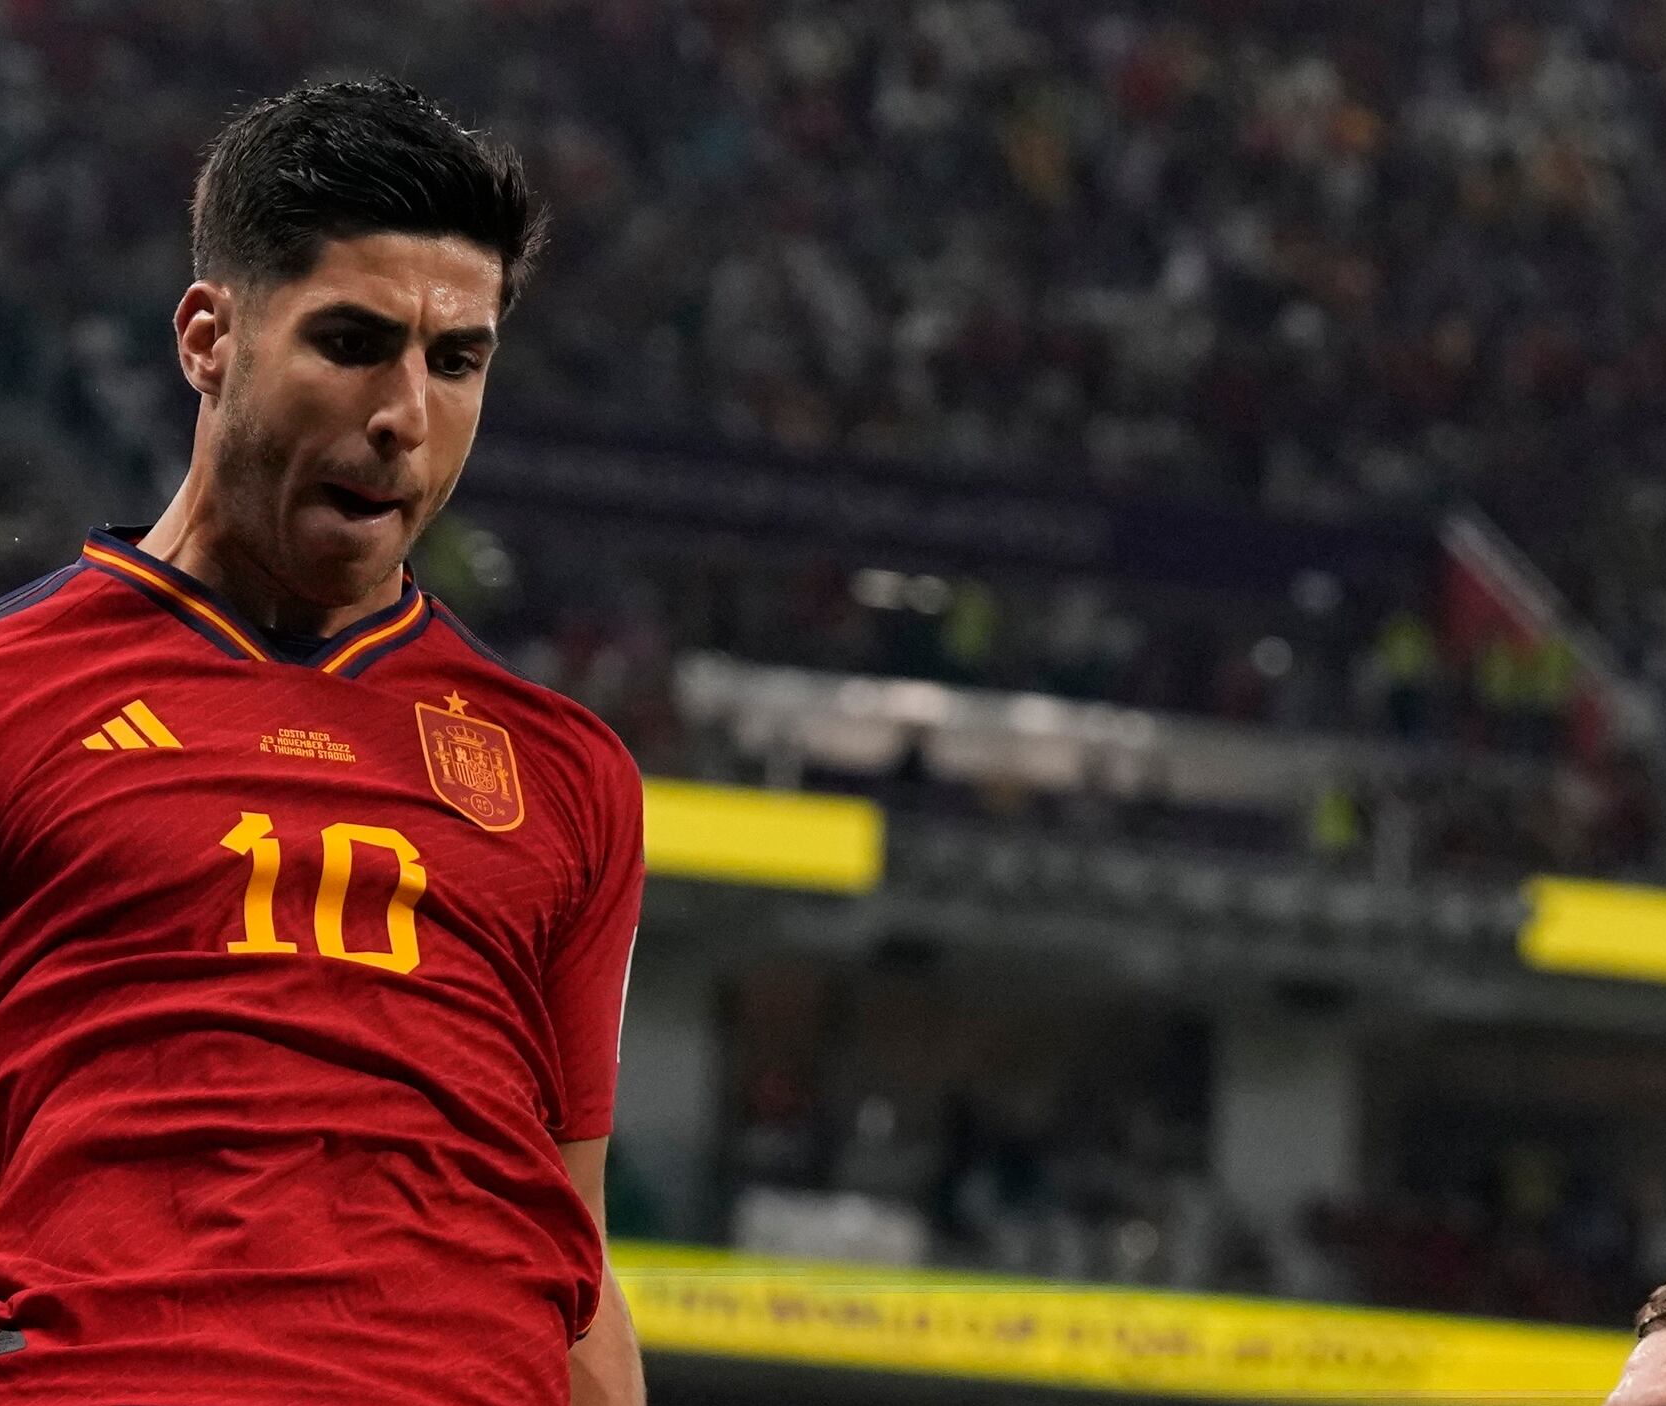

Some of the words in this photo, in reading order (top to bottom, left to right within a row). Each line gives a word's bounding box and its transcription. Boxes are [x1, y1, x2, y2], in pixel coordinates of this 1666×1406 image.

[261, 735, 274, 744] 23
[277, 737, 324, 750] NOVEMBER
[326, 742, 351, 753] 2022
[278, 728, 306, 739] COSTA
[309, 731, 331, 742] RICA
[259, 742, 271, 753] AL
[273, 745, 315, 758] THUMAMA
[318, 750, 356, 762] STADIUM
[219, 811, 427, 975] 10
